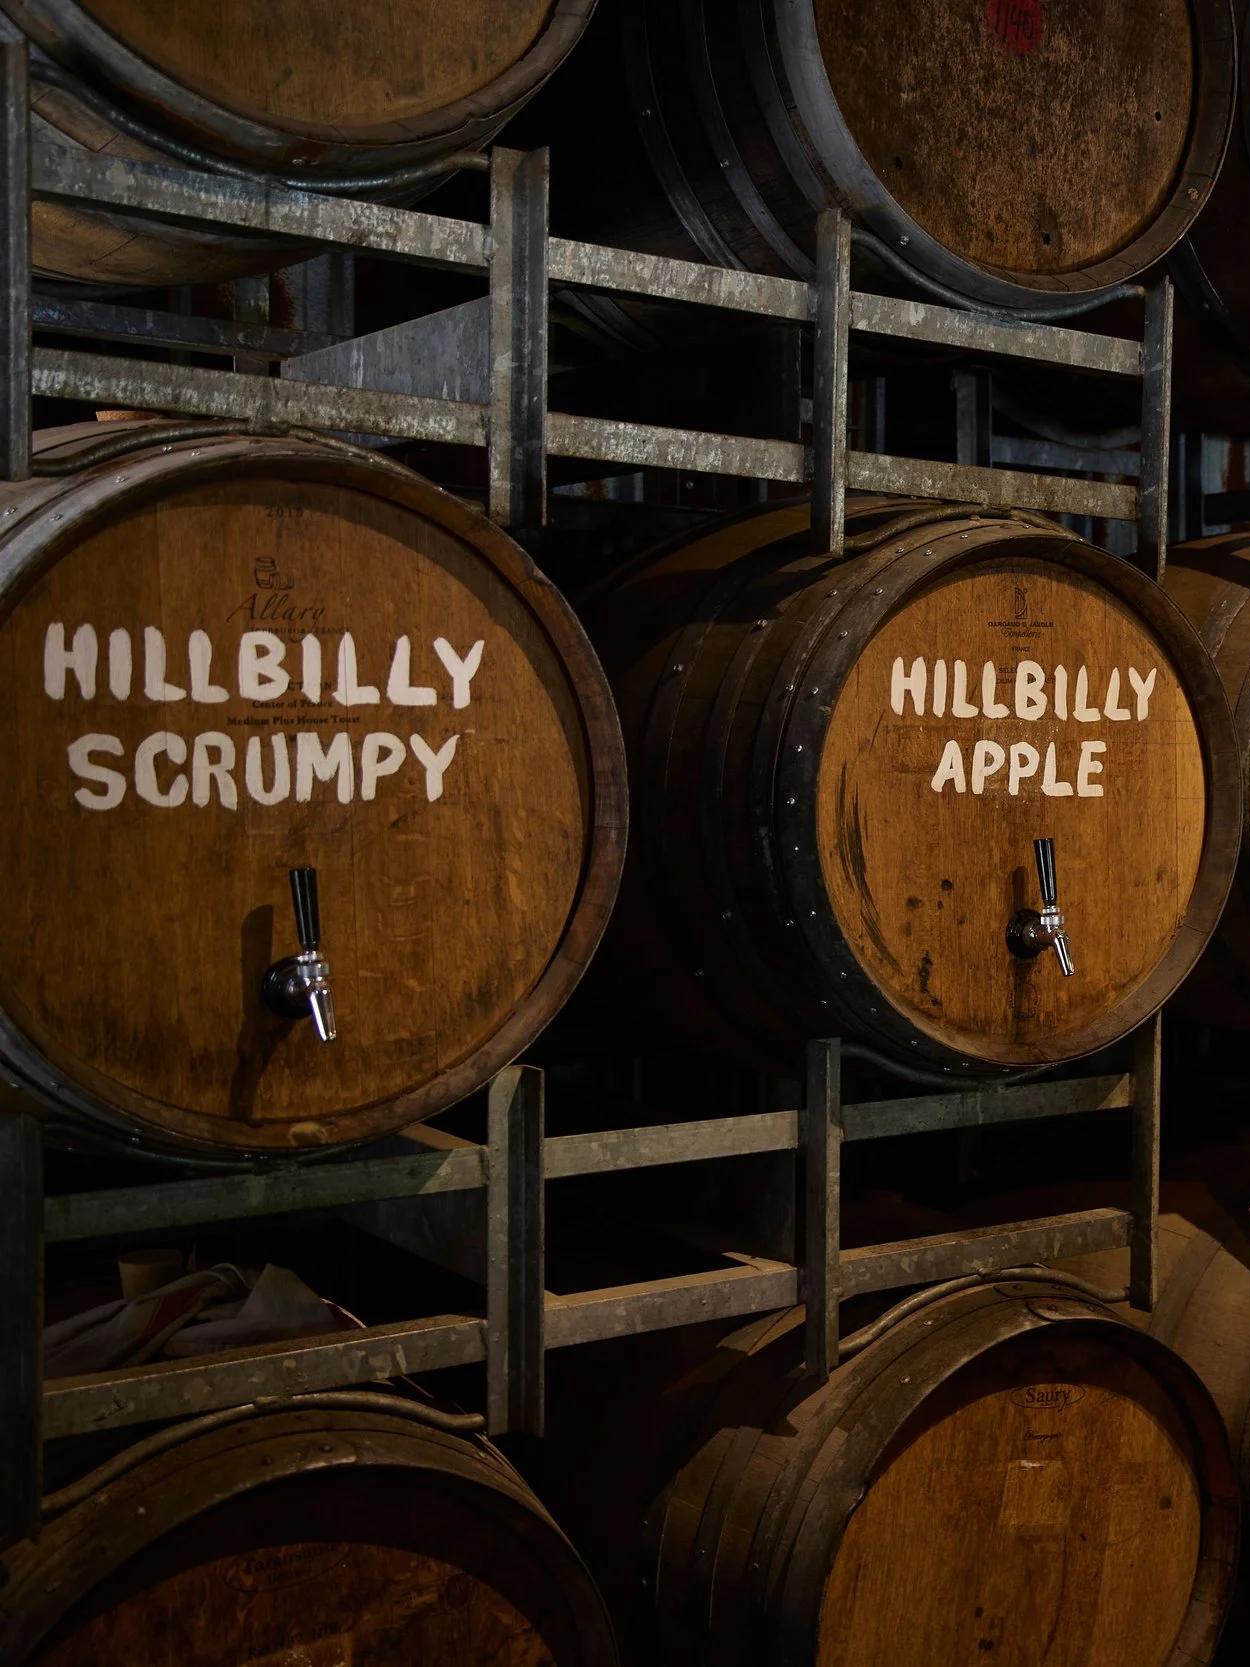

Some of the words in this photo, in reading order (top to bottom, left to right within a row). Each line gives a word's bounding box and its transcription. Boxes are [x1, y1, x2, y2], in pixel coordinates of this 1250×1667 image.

[44, 622, 485, 709] HILLBILLY
[891, 656, 1157, 722] HILLBILLY
[227, 716, 270, 726] Medium
[272, 715, 295, 725] Plus
[331, 714, 360, 724] Toast
[67, 731, 460, 811] SCRUMPY
[930, 739, 1107, 798] APPLE
[1025, 1387, 1071, 1412] Saury
